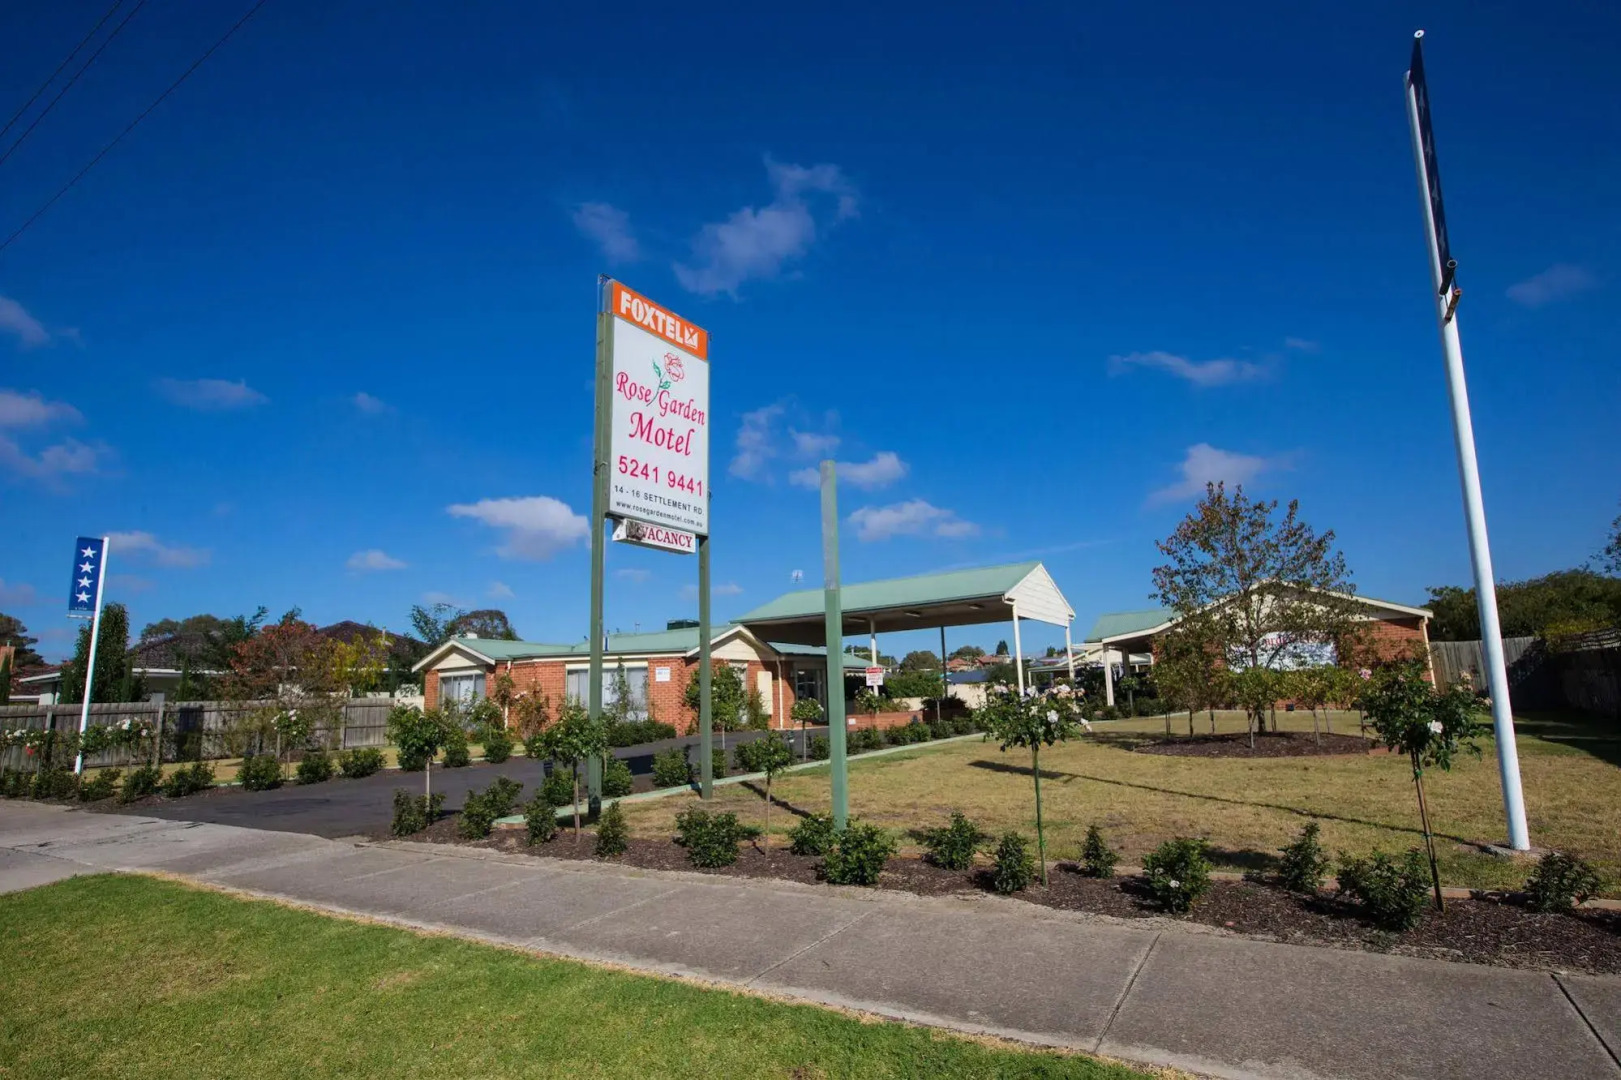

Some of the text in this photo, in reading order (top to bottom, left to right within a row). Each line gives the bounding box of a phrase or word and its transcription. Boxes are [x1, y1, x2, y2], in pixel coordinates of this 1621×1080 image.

[620, 290, 684, 344] FOXTEL
[616, 371, 705, 426] Rose Garden
[628, 411, 695, 456] Motel
[618, 455, 702, 497] 5241 9441
[614, 485, 624, 494] 14
[631, 489, 641, 498] 16
[643, 492, 691, 512] SETTLEMENT
[616, 501, 703, 528] www.rosegardenmotel.com.au
